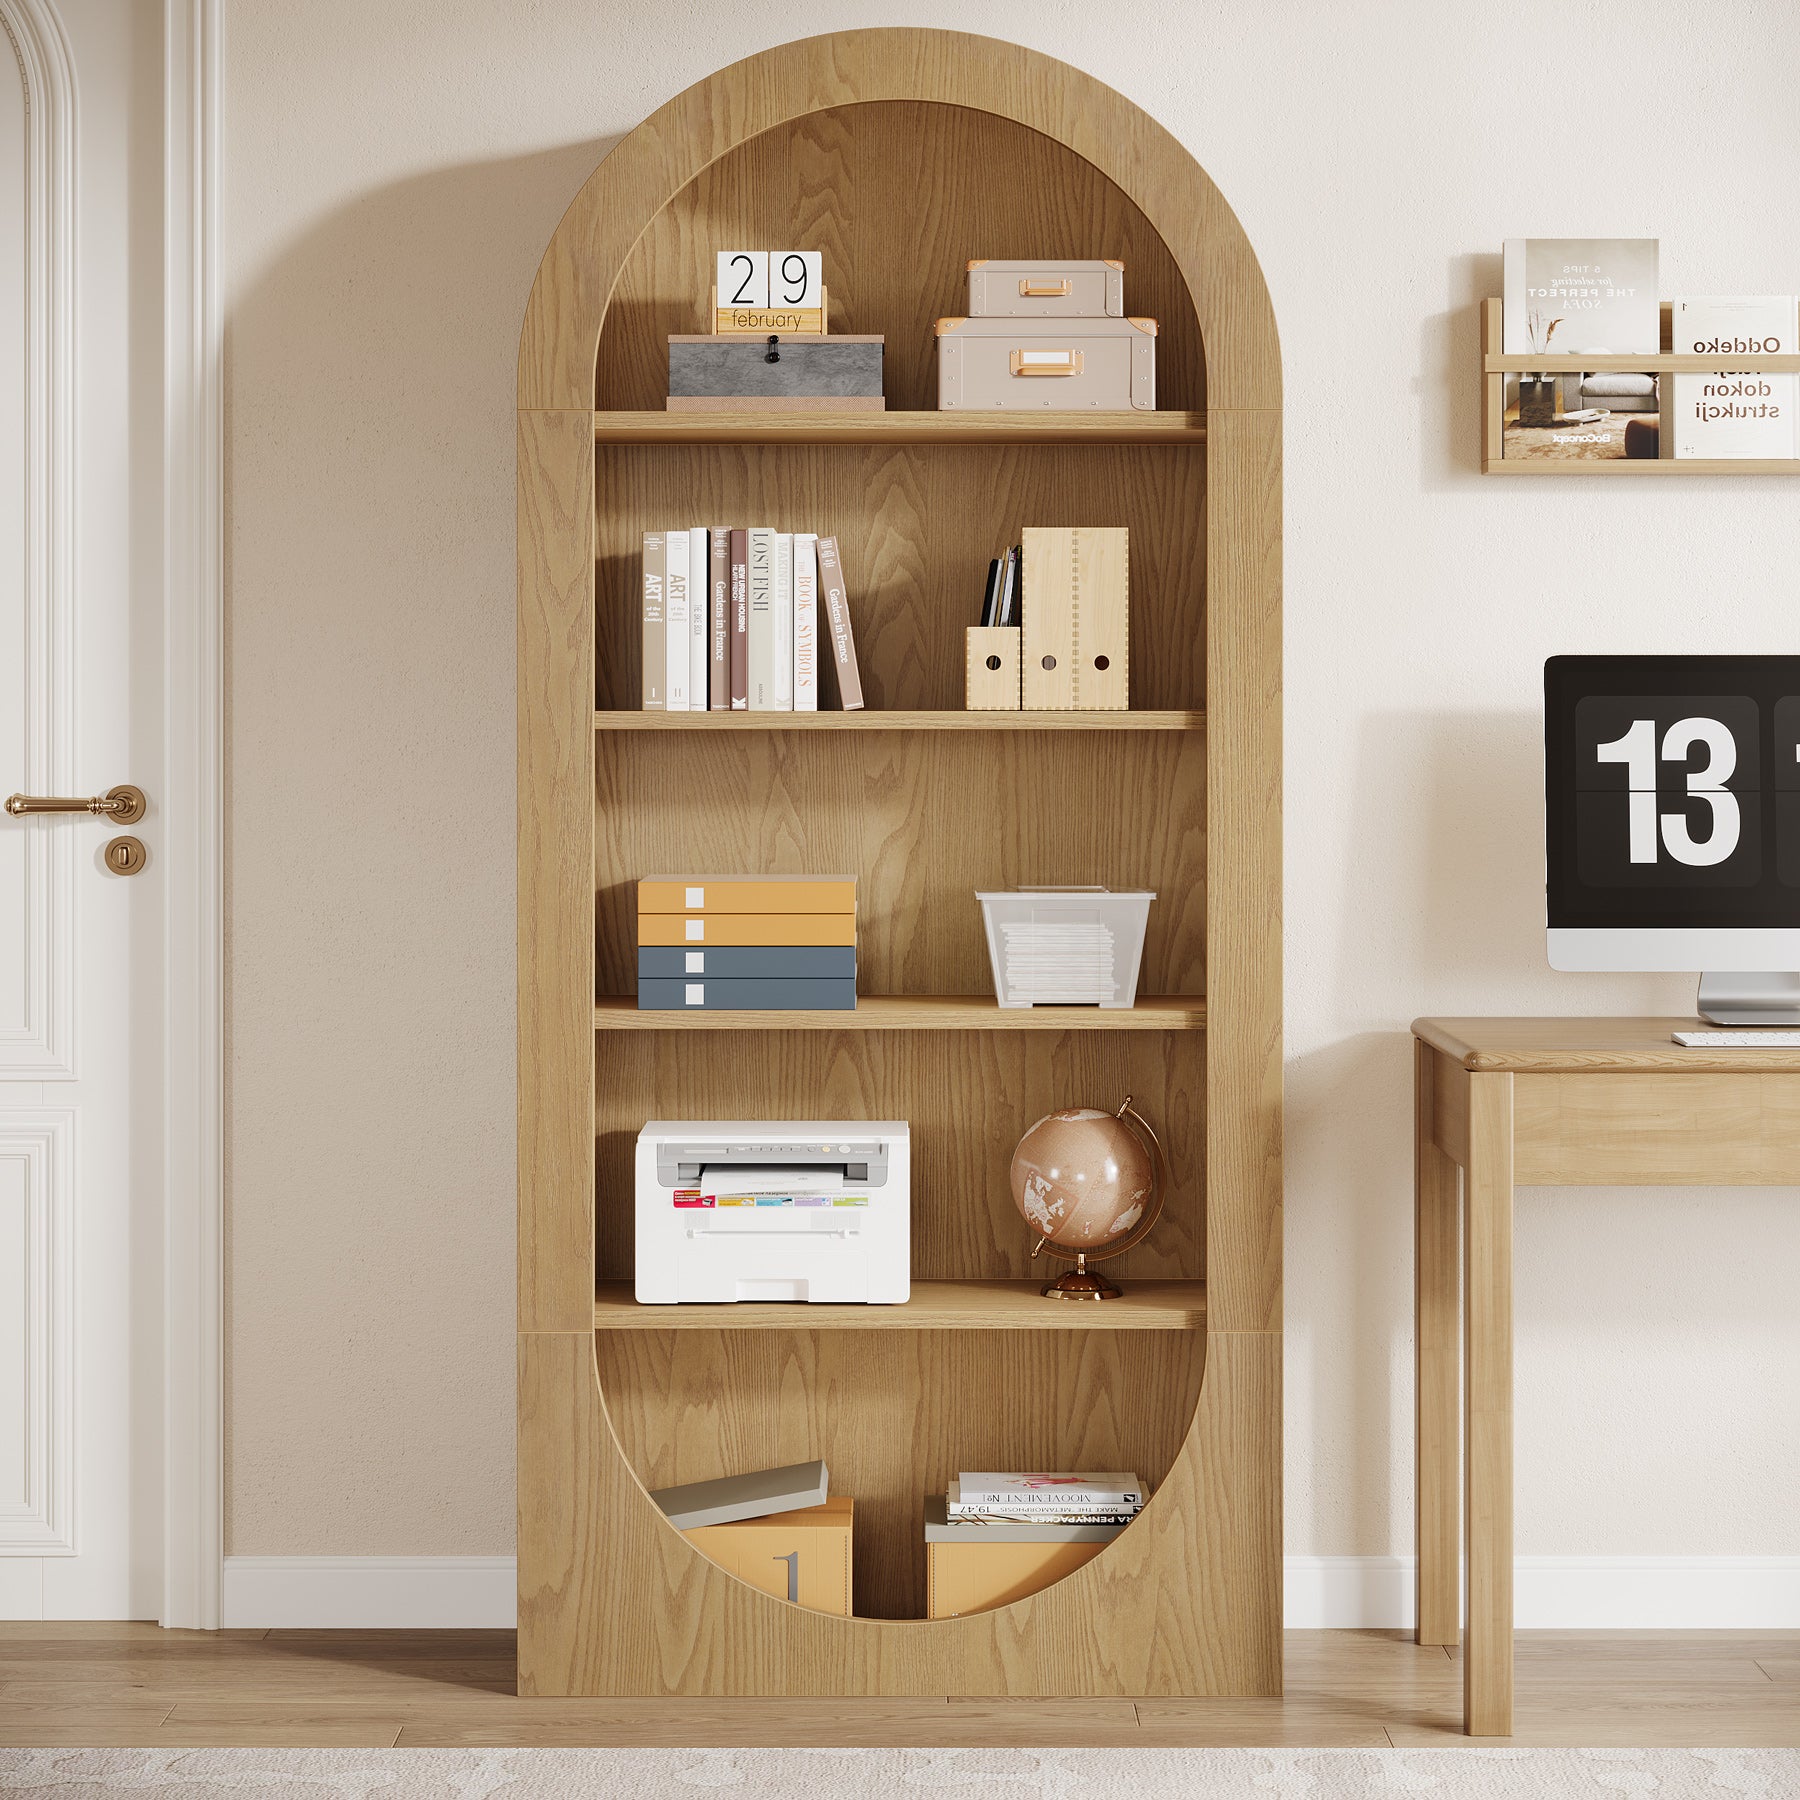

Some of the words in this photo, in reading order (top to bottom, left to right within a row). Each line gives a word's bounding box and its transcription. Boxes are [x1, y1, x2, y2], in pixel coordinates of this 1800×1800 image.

[732, 309, 802, 332] february
[752, 533, 769, 573] LOST
[777, 542, 788, 586] MAKING
[738, 564, 746, 579] NEW
[645, 573, 662, 602] ART
[670, 573, 686, 602] ART
[715, 581, 727, 618] Gardens
[738, 580, 746, 602] URBAN
[752, 577, 769, 611] FISH
[777, 588, 788, 600] IT
[798, 576, 812, 611] BOOK
[693, 604, 703, 613] THE
[738, 603, 746, 633] HOUSING
[829, 588, 843, 623] Gardens
[693, 624, 703, 636] BOOK
[715, 619, 727, 629] in
[836, 624, 846, 634] in
[715, 630, 727, 662] France
[798, 624, 812, 687] SYMBOLS
[838, 634, 850, 664] France
[1596, 717, 1741, 867] 13
[1004, 1493, 1091, 1503] MOOVEMENT
[1030, 1515, 1115, 1523] PENNYPACKER
[772, 1550, 799, 1604] 1
